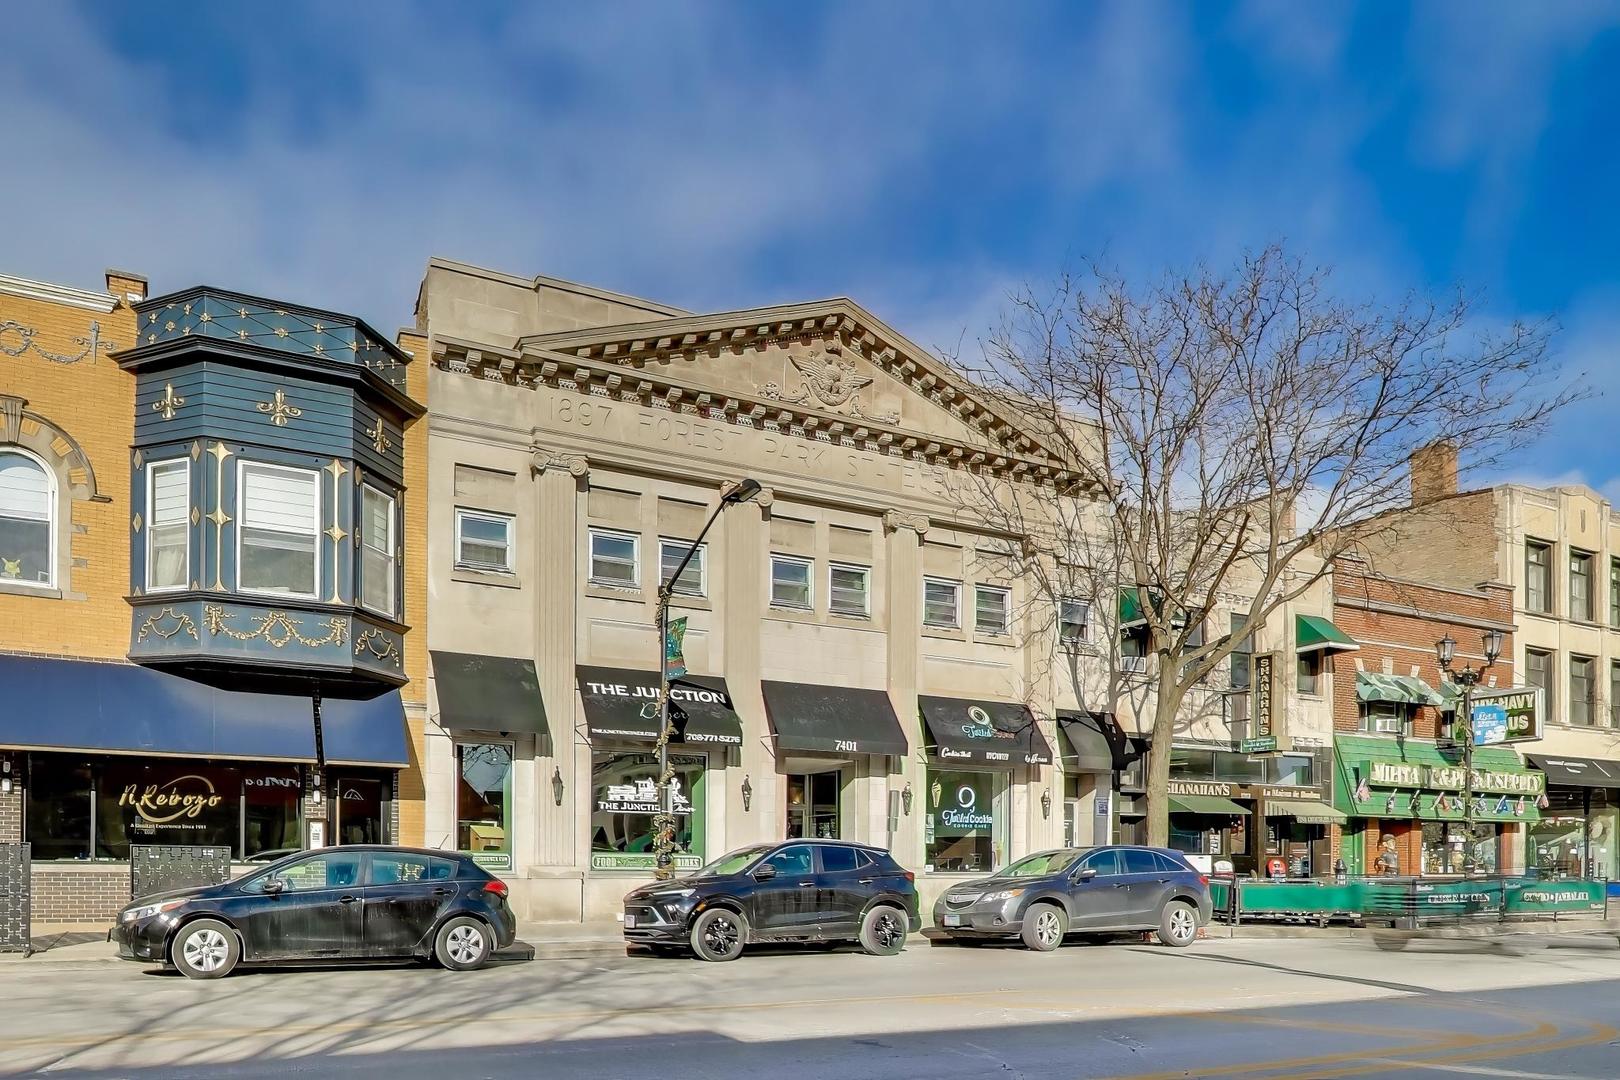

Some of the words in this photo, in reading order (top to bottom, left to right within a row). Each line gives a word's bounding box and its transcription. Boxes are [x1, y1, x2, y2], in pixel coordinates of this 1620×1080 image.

[550, 396, 612, 426] 1897
[637, 412, 743, 453] FOREST
[586, 682, 630, 697] THE
[834, 740, 857, 752] 7401
[597, 801, 619, 810] THE
